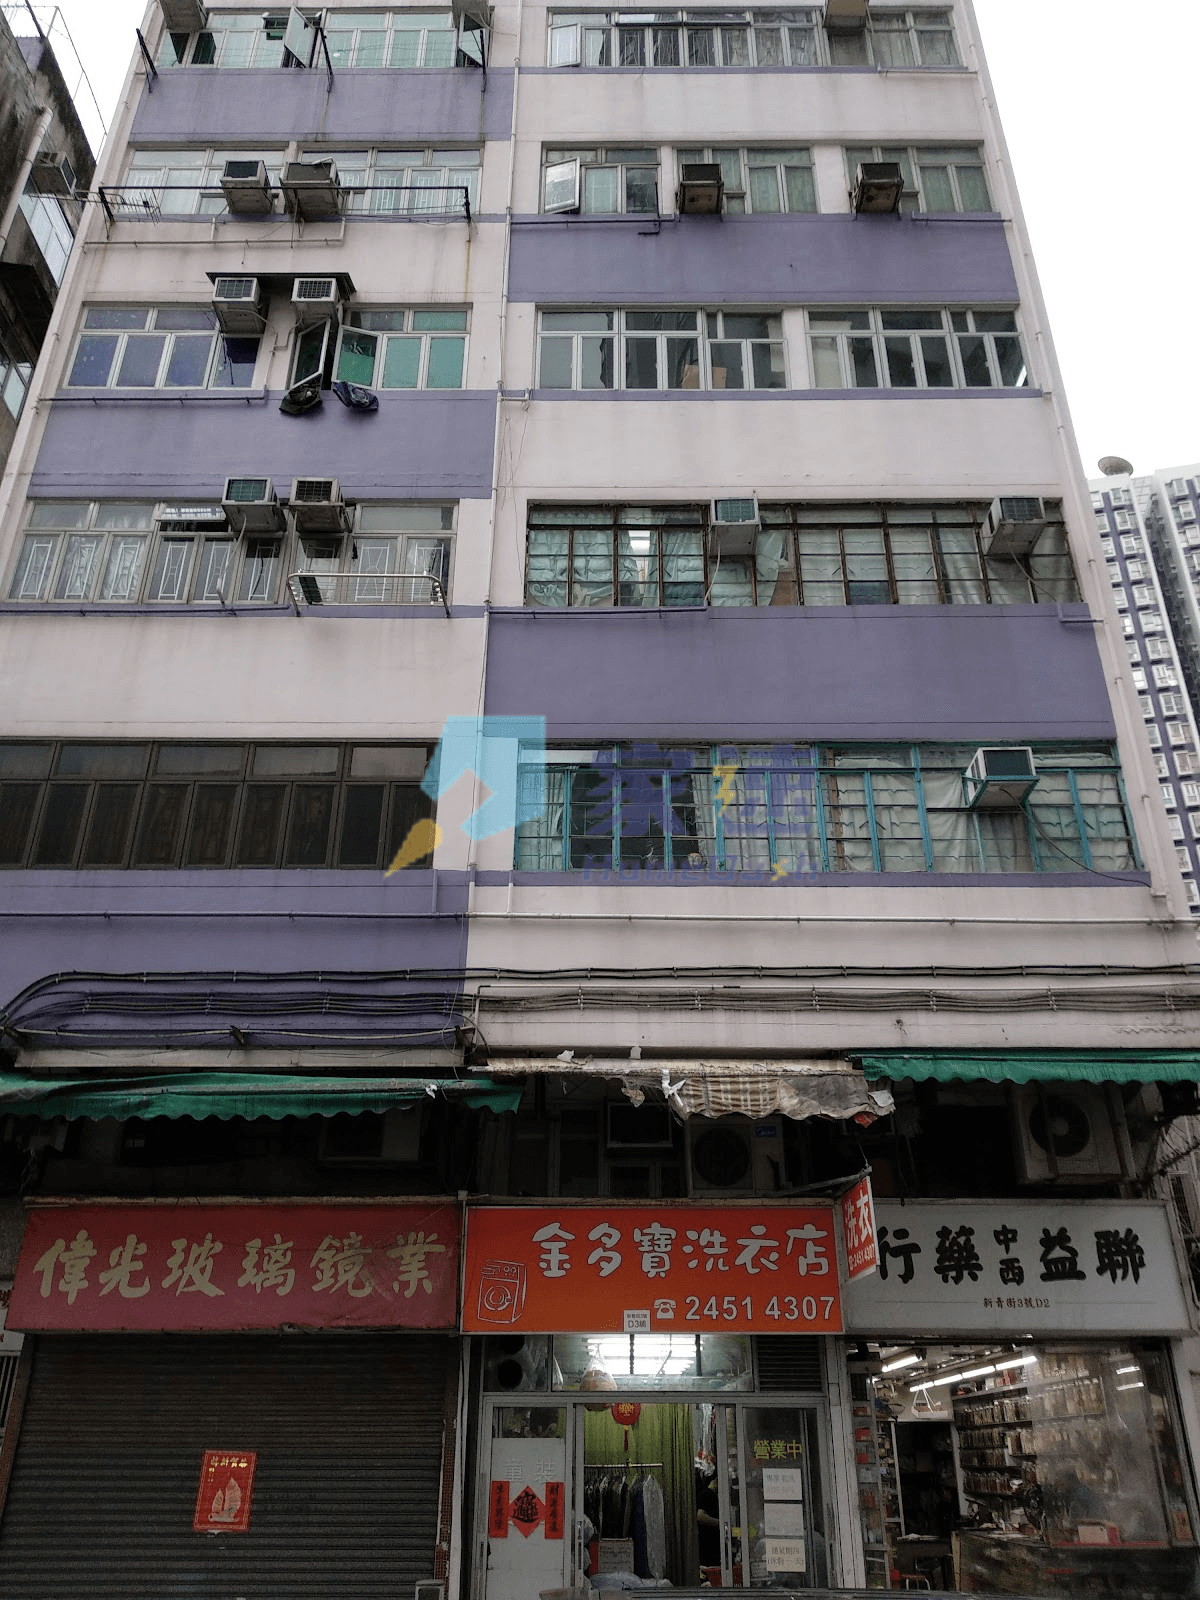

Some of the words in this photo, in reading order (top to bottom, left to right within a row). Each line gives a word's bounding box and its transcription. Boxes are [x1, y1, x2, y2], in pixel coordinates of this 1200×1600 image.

[845, 1189, 873, 1250] 洗衣
[33, 1229, 447, 1304] 偉光玻璃鏡業
[532, 1221, 830, 1279] 金多寶洗衣店
[685, 1295, 754, 1321] 2451
[766, 1295, 836, 1321] 4307
[754, 1439, 803, 1460] 營業中
